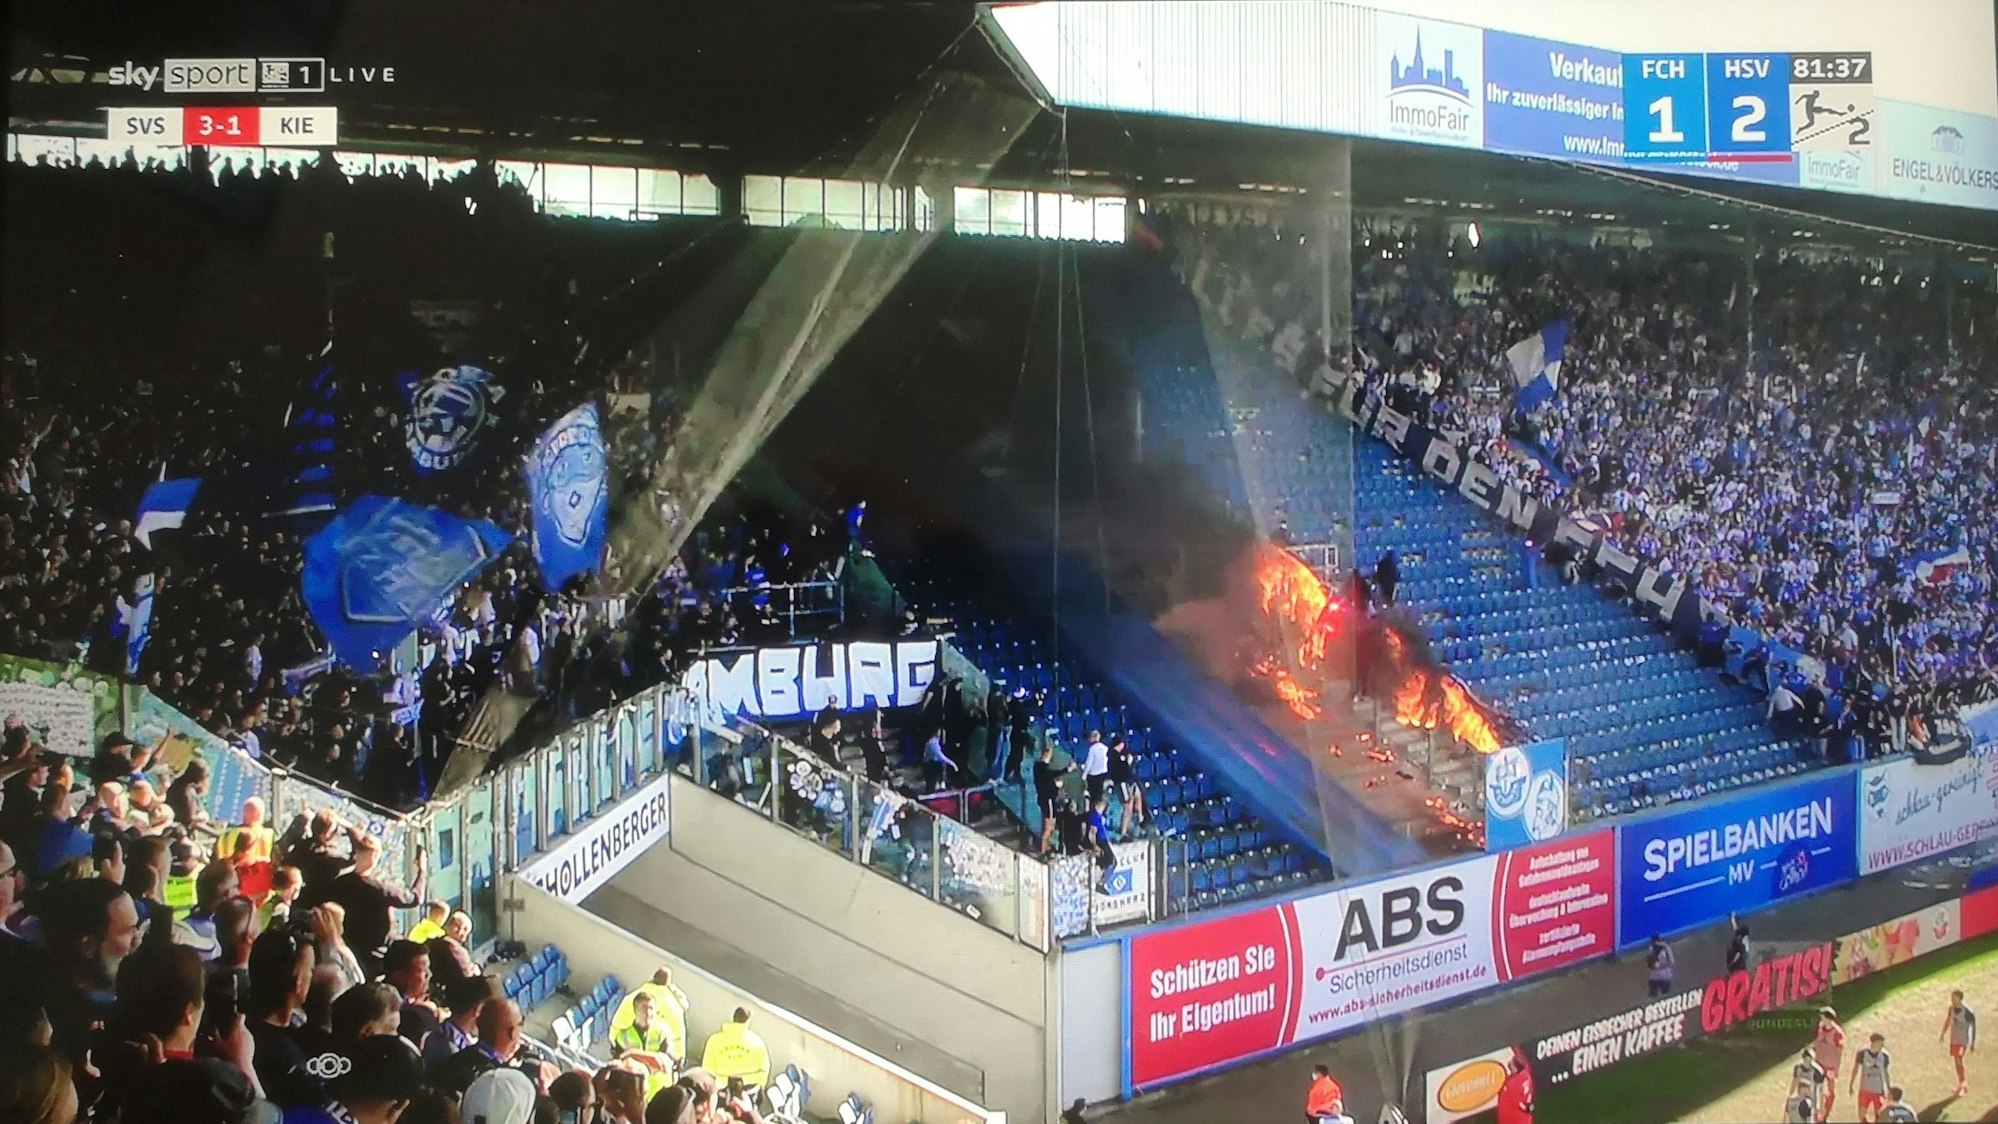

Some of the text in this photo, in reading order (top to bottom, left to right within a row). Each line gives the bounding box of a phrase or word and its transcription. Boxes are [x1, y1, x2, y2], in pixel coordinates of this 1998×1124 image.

[108, 61, 395, 91] sky sport 1 LIVE
[1642, 59, 1685, 79] FCH
[1725, 58, 1770, 79] HSV
[1793, 58, 1867, 78] 81:37
[1390, 99, 1469, 131] ImmoFair
[1487, 82, 1508, 104] Ihr
[126, 116, 166, 135] SVS
[199, 116, 242, 135] 3-1
[280, 116, 314, 135] KIE
[1649, 96, 1685, 144] 1
[1731, 95, 1767, 143] 2
[1808, 156, 1861, 180] ImmoFair
[1422, 437, 1541, 530] DEN
[682, 640, 938, 721] AMBURG
[536, 791, 667, 897] HOLLENBERGER
[1643, 796, 1832, 881] SPIELBANKEN
[1728, 859, 1755, 885] MV
[1333, 876, 1466, 962] ABS
[1150, 945, 1276, 999] Schützen Sie
[1329, 942, 1468, 994] Sicherheitsdienst
[1701, 941, 1834, 1034] GRATIS!
[1150, 984, 1276, 1043] Ihr Eigentum!
[1308, 965, 1487, 1024] www.abs-sicherheitsdienst.de
[1536, 1028, 1582, 1060] DEINEN
[1644, 988, 1703, 1024] BESTELLEN
[1571, 1037, 1623, 1076] EINEN
[1624, 1013, 1686, 1058] KAFFEE
